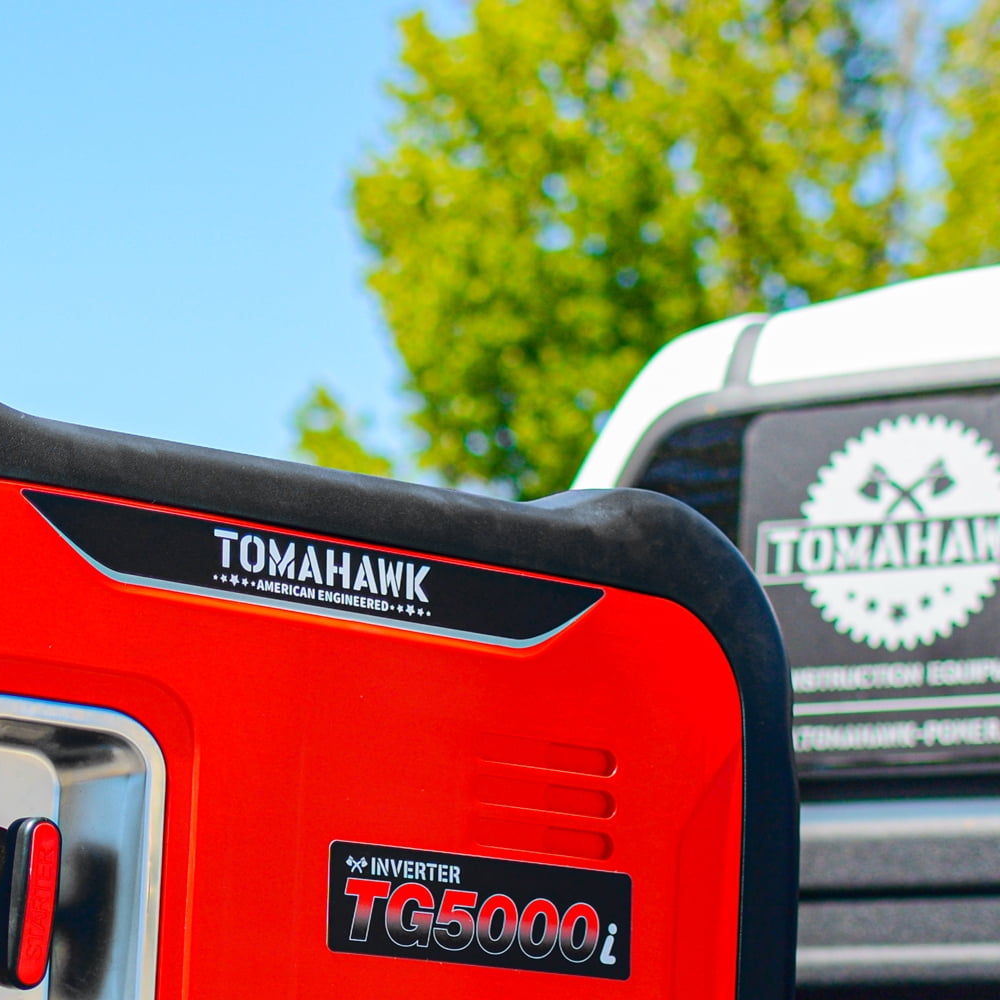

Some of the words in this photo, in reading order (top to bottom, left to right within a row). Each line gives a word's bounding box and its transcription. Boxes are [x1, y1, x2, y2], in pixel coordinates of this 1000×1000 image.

[214, 528, 430, 602] TOMAHAWK
[257, 579, 315, 600] AMERICAN
[317, 590, 388, 612] ENGINEERED
[371, 857, 461, 884] INVERTER
[26, 847, 53, 960] STARTER
